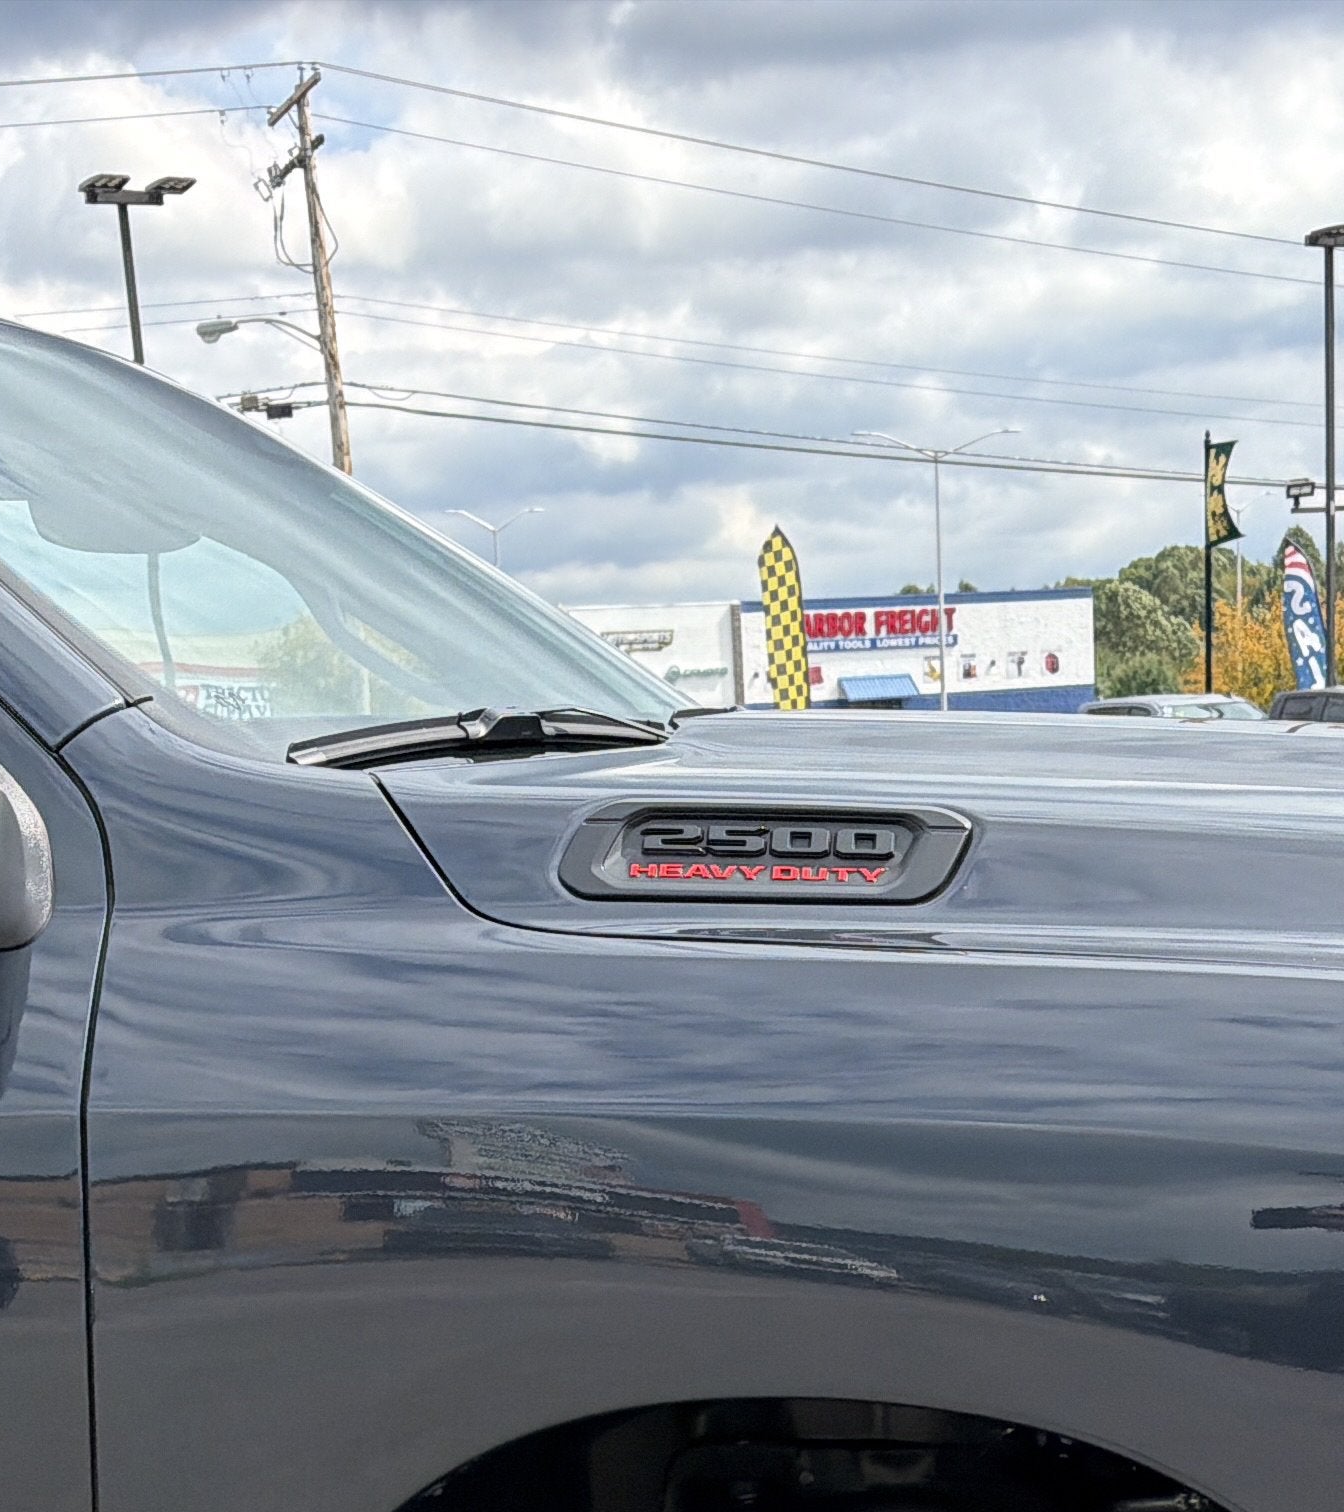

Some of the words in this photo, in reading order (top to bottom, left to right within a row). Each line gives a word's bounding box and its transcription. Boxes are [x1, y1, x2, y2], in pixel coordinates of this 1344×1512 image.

[803, 612, 867, 639] ARBOR
[874, 607, 956, 637] FREIGHT
[807, 639, 836, 650] ALITY
[838, 639, 872, 650] TOOLS
[876, 636, 917, 648] LOWEST
[641, 825, 896, 860] 2500
[628, 863, 765, 881] HEAVY
[771, 865, 890, 884] DUTY
